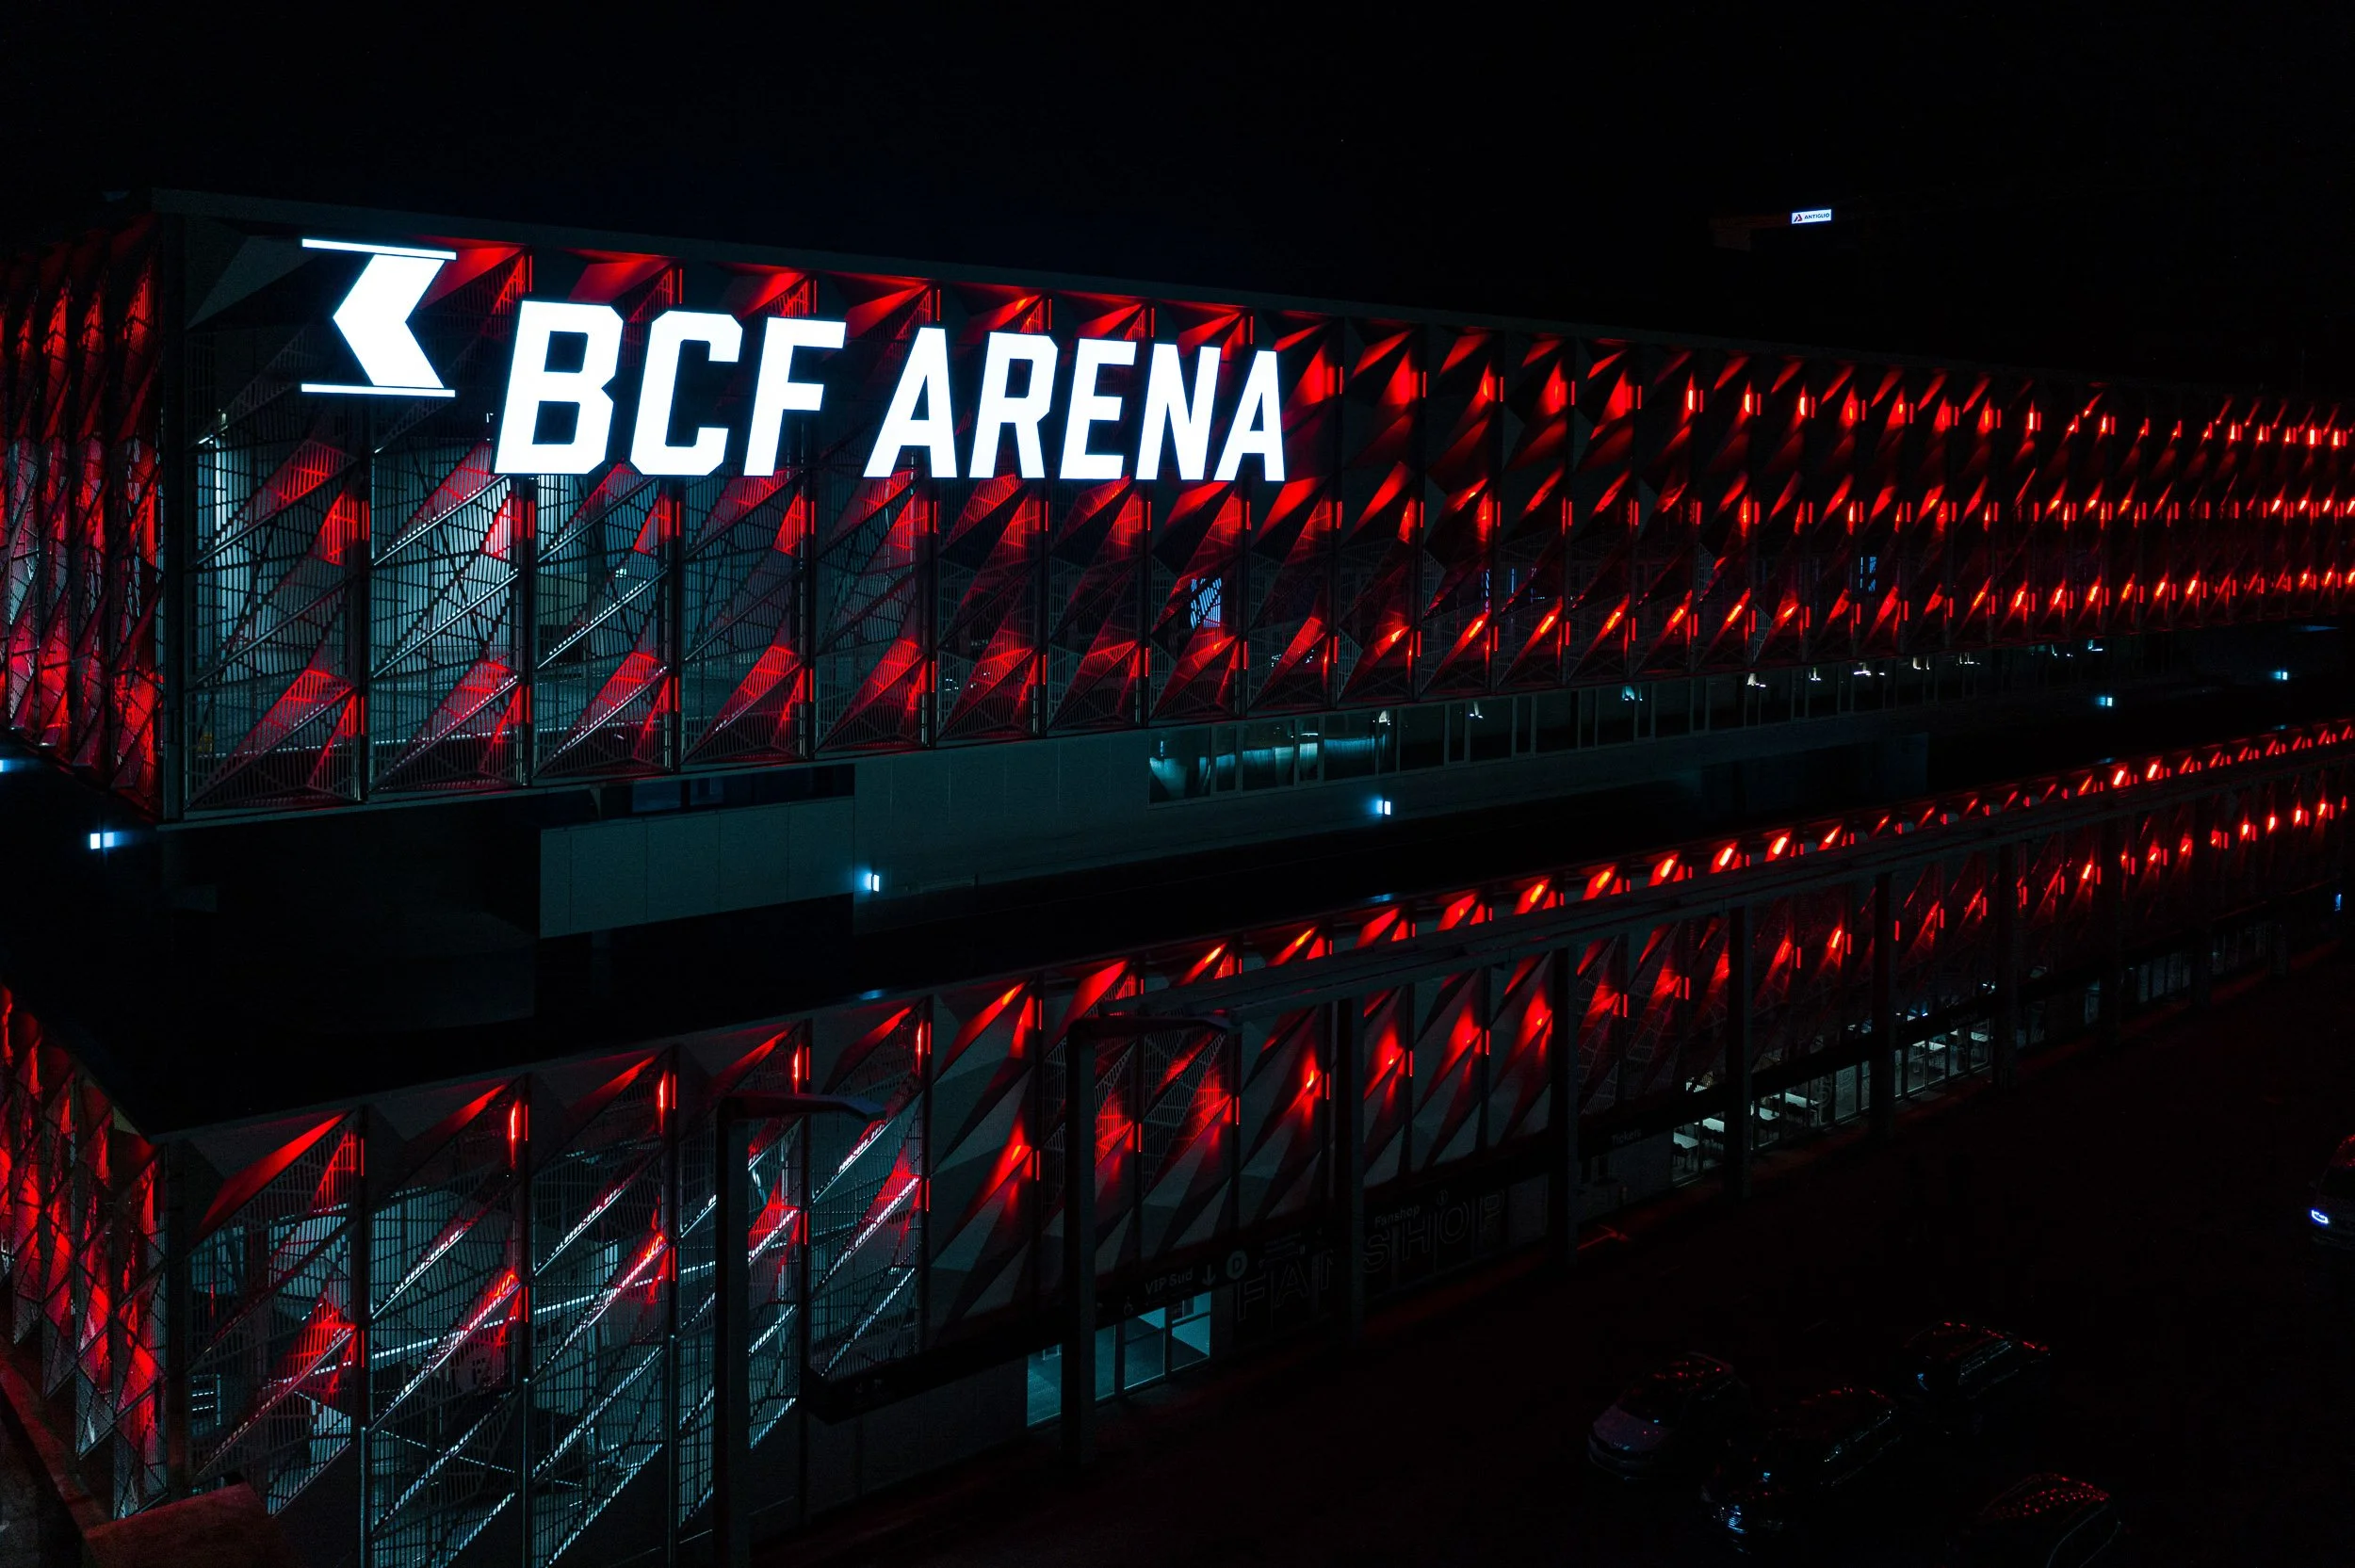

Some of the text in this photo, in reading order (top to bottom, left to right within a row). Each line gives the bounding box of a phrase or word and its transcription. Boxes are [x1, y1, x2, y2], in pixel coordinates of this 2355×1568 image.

[494, 299, 1286, 482] BCF ARENA
[1611, 1128, 1643, 1147] Tickets
[1373, 1204, 1421, 1229] Fanshop
[1362, 1189, 1506, 1273] SHOP
[1145, 1267, 1194, 1295] VIP Sud
